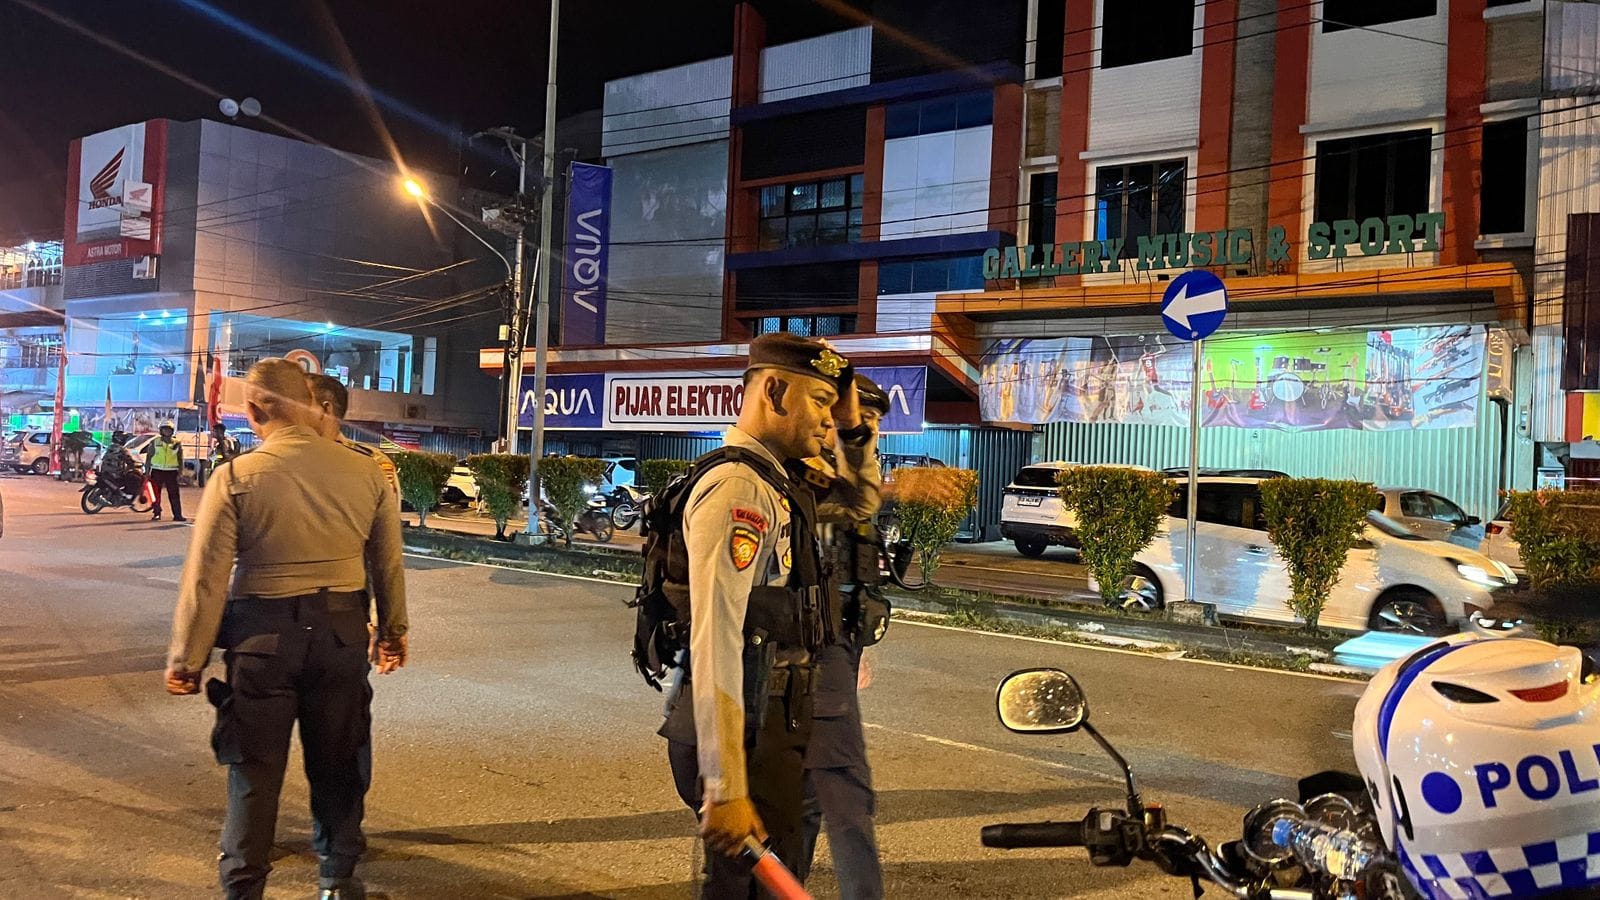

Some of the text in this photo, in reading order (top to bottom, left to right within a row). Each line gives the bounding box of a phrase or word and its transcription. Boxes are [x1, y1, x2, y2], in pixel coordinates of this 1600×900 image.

[88, 195, 123, 210] HONDA
[87, 246, 104, 258] ASTRA
[573, 208, 602, 314] AQUA
[982, 212, 1445, 280] GALLERY MUSIC & SPORT
[520, 388, 595, 415] AQUA
[615, 385, 662, 416] PIJAR
[1473, 744, 1600, 809] POL
